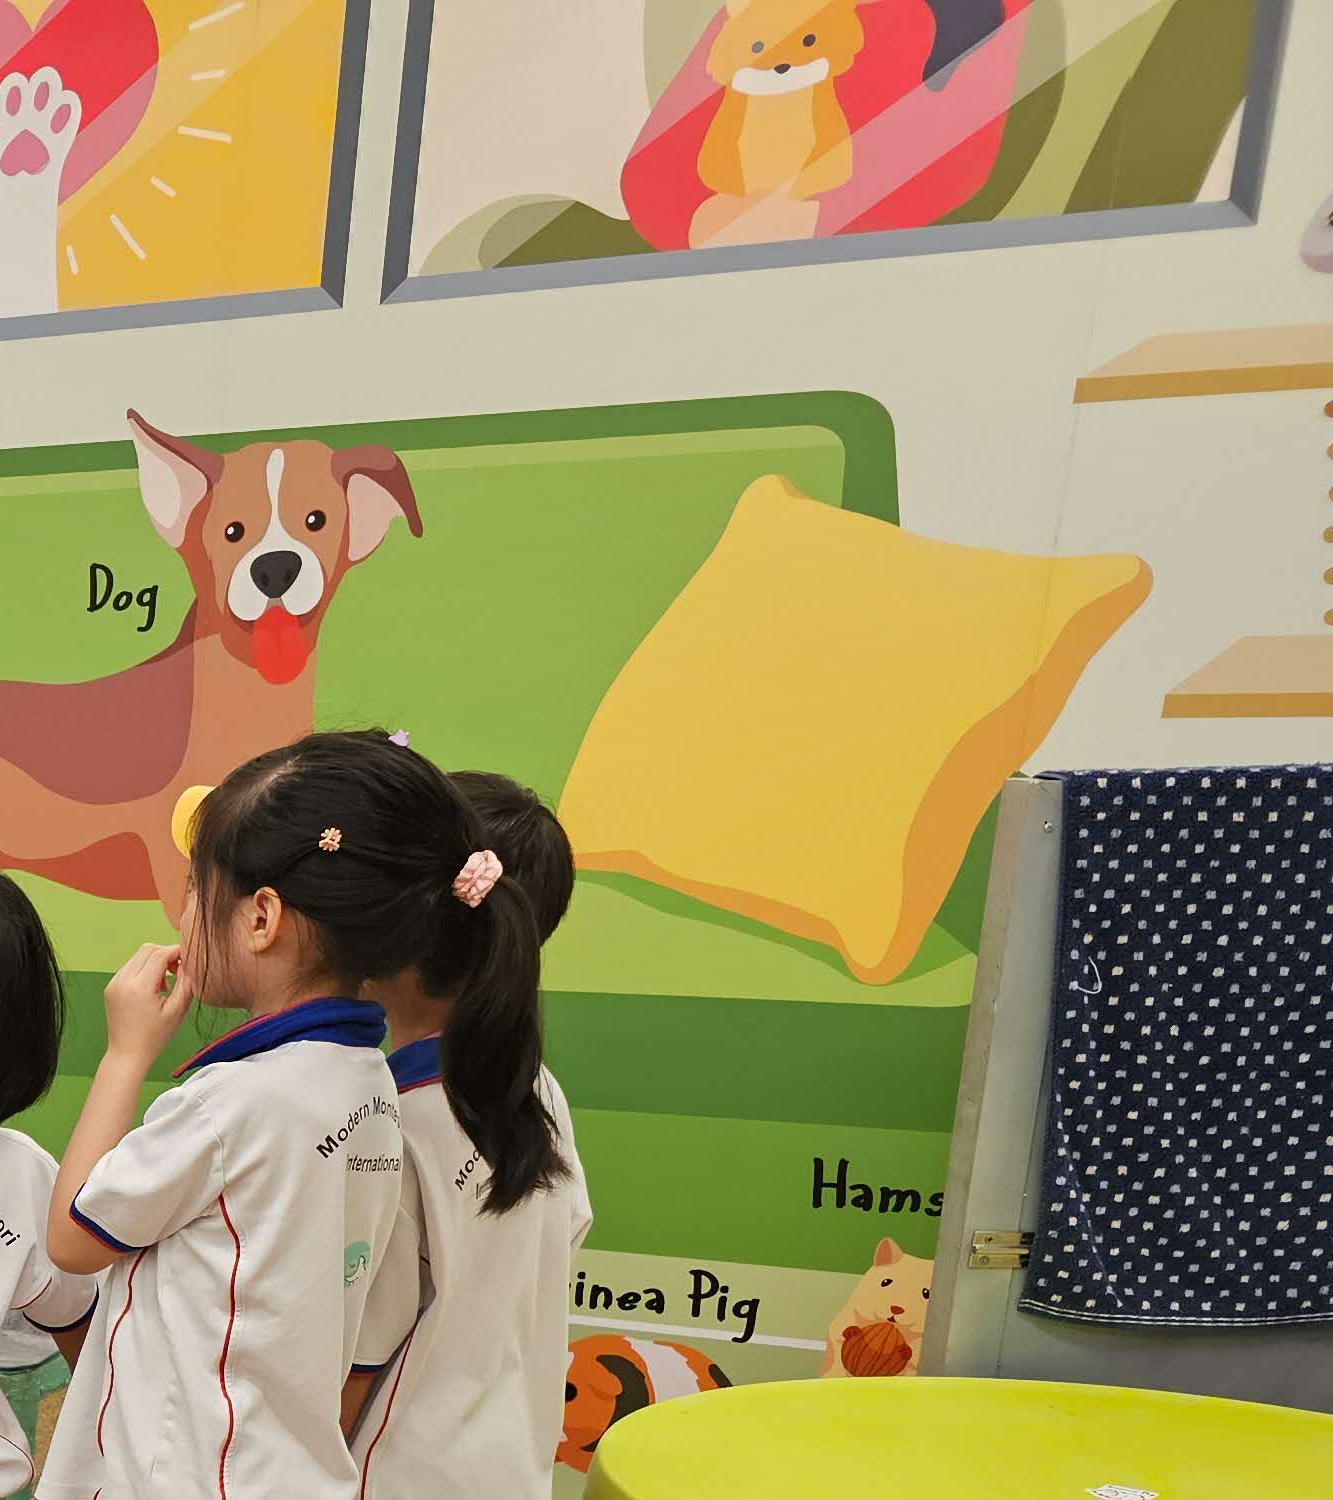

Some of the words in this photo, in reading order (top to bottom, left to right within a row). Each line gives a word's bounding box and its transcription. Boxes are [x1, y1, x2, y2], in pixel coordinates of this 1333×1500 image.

[87, 563, 159, 632] Dog
[316, 1103, 369, 1159] Modern
[812, 1157, 945, 1217] Hams
[569, 1271, 666, 1314] inea
[688, 1268, 760, 1343] Pig
